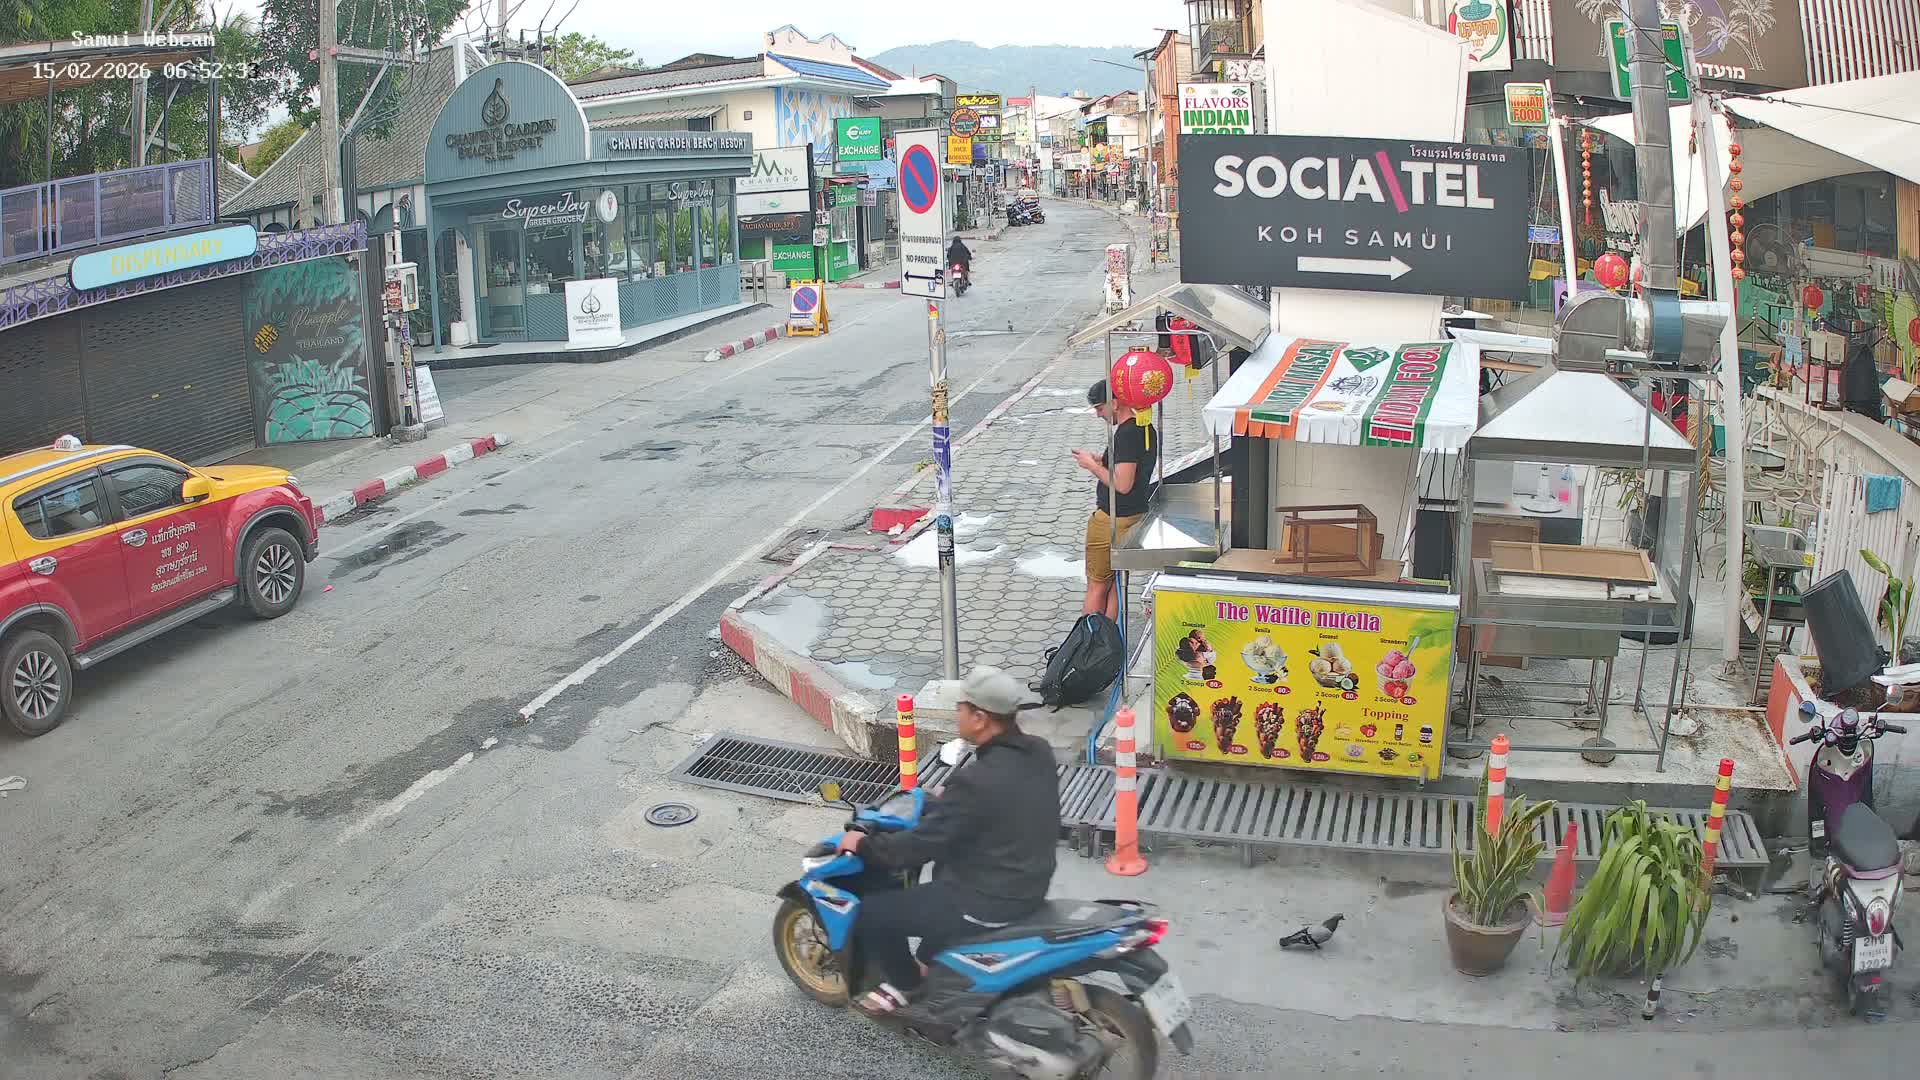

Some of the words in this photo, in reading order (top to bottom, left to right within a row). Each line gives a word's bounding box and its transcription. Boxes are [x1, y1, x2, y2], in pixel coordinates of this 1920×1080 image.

[1185, 97, 1249, 109] FLAVORS
[1510, 95, 1543, 107] INDIAN
[1183, 110, 1250, 127] INDIAN
[1513, 109, 1542, 121] FOOD
[504, 119, 557, 137] GARDEN
[612, 138, 655, 150] CHAWENG
[658, 138, 691, 149] GARDEN
[693, 138, 718, 149] BEACH
[720, 138, 746, 149] RESORT
[839, 145, 879, 155] EXCHANGE
[740, 176, 799, 186] CHAWENG
[552, 214, 582, 225] GROCER
[1258, 225, 1322, 244] KOH
[1345, 228, 1451, 251] SAMUI
[111, 239, 223, 276] DISPENSARY
[773, 250, 811, 260] EXCHANGE
[906, 254, 914, 262] NO
[914, 255, 938, 264] PARKING
[296, 336, 345, 350] THAILAND
[1216, 601, 1249, 621] The
[1254, 605, 1311, 627] Waffle
[1316, 609, 1381, 633] nutella
[1380, 638, 1408, 646] Strawberry
[1361, 707, 1409, 722] Topping
